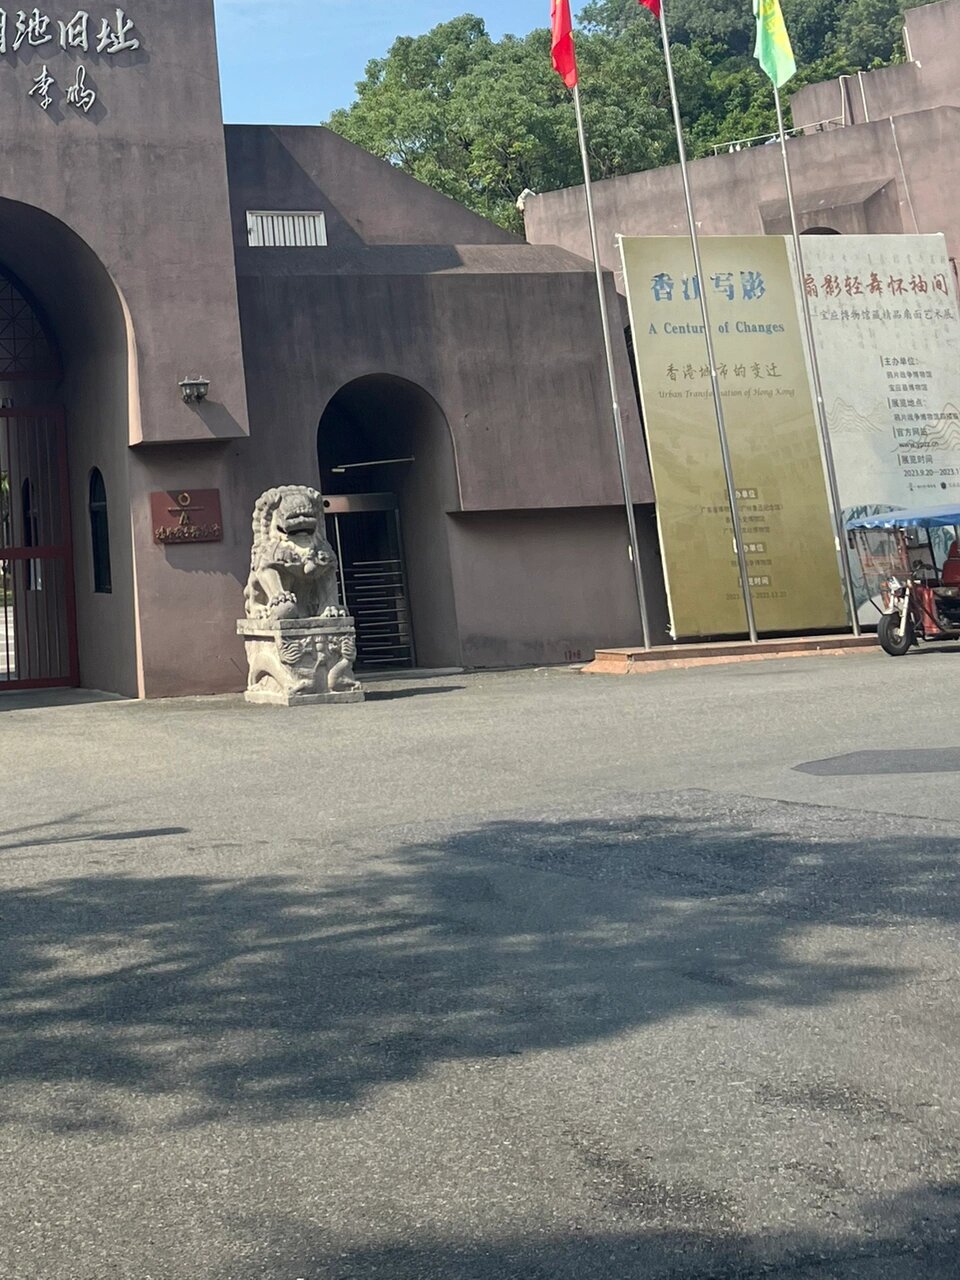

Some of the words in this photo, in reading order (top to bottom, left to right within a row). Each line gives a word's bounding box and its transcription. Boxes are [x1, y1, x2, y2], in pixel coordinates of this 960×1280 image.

[648, 323, 657, 335] A
[663, 322, 707, 335] Centur
[718, 321, 729, 334] of
[736, 321, 785, 335] Changes
